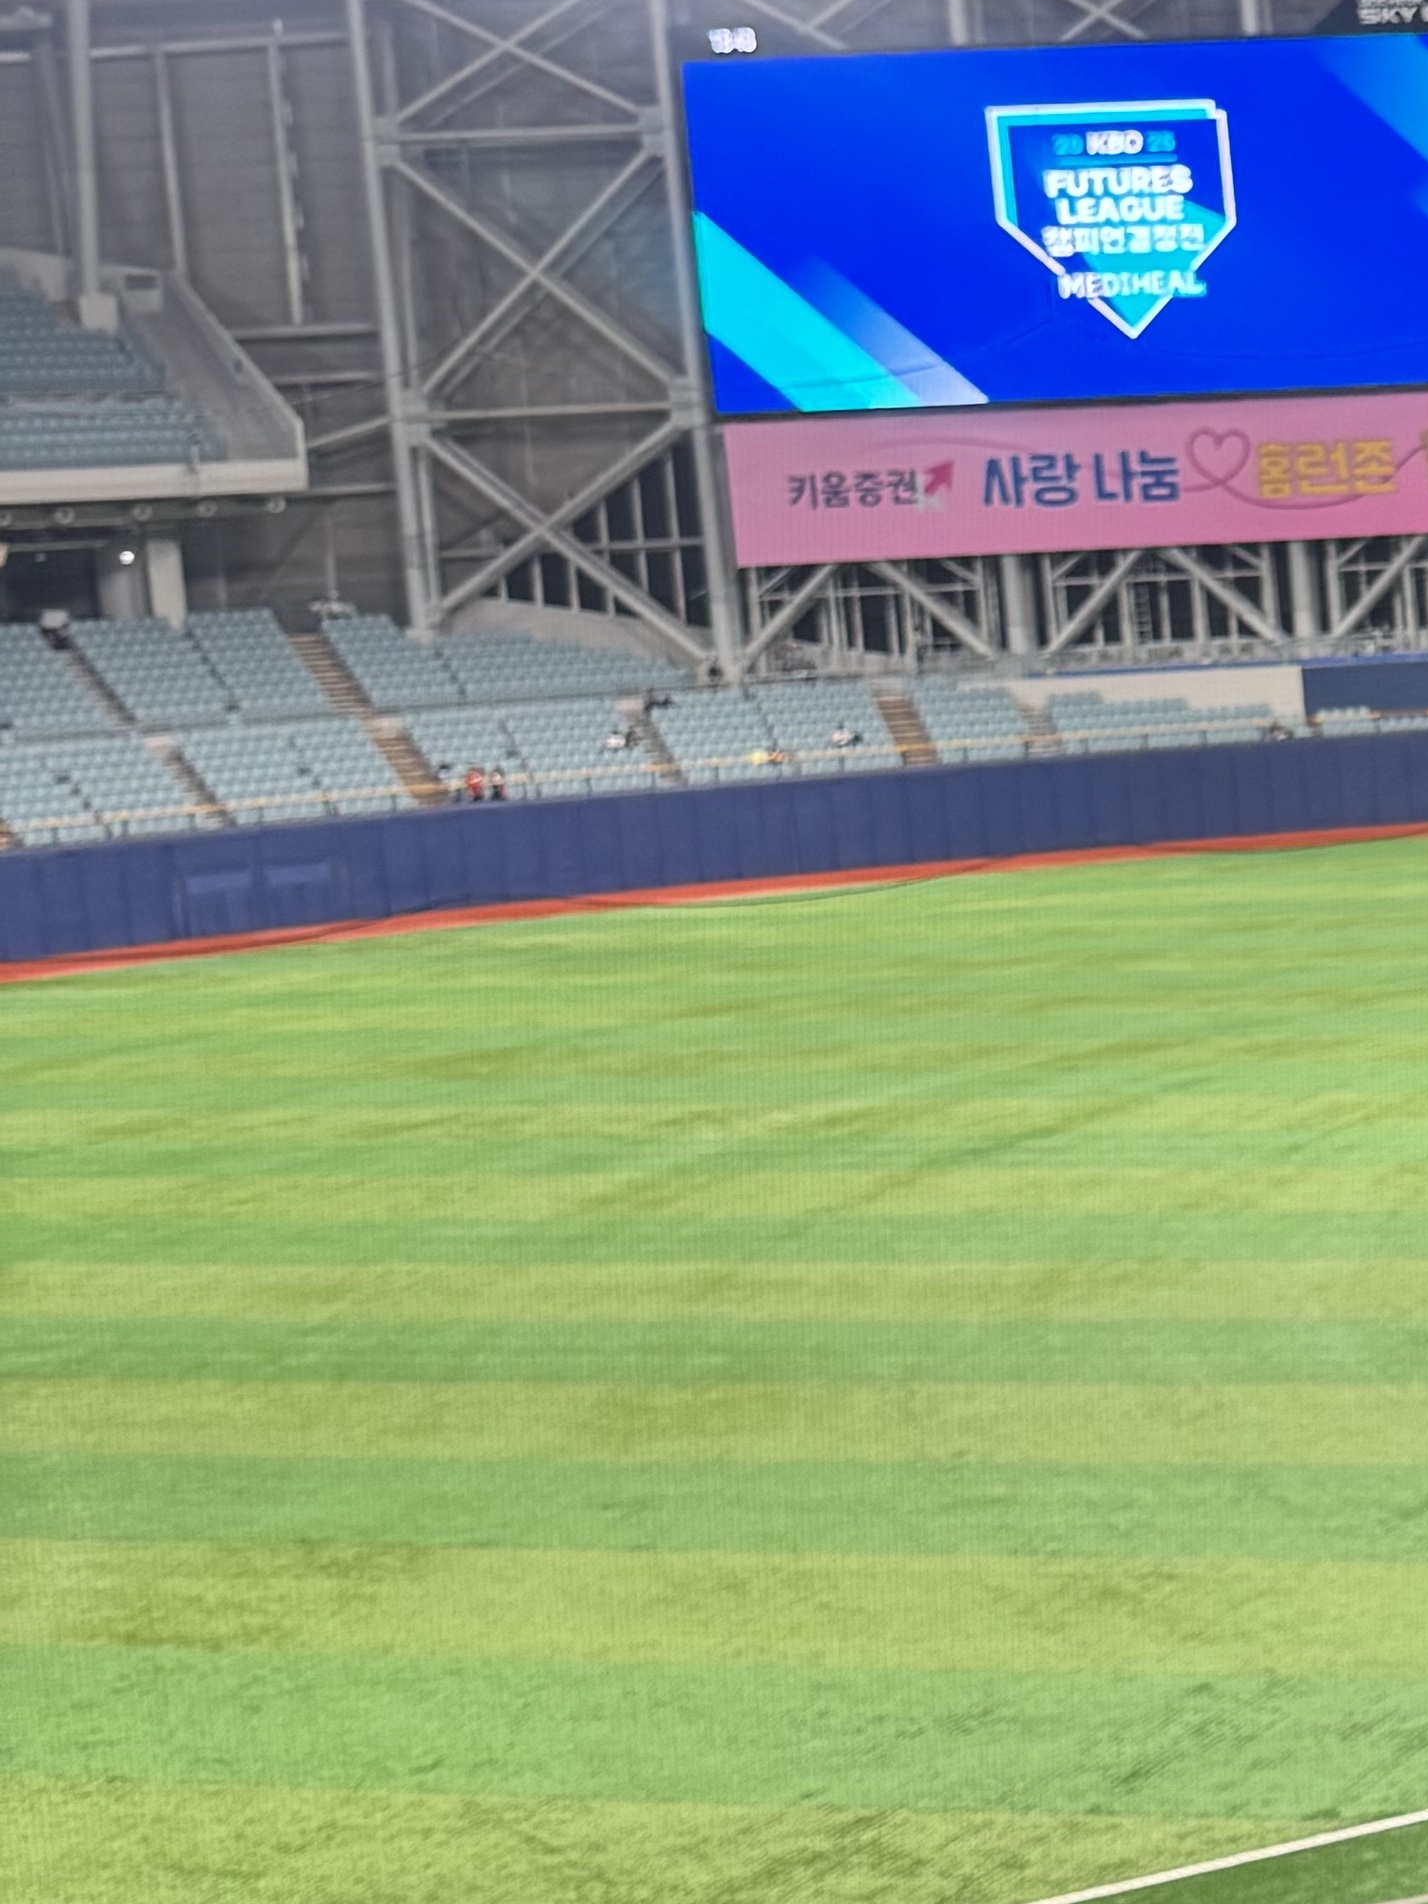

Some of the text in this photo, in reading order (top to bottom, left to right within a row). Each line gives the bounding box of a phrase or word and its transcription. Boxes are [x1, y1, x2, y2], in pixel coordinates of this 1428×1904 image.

[1358, 5, 1418, 25] SKY
[1086, 129, 1144, 155] KBO
[1043, 164, 1193, 198] FUTURES
[1055, 195, 1185, 225] LEAGUE
[1057, 270, 1207, 299] MEDIHEAL
[787, 441, 1396, 510] 키움증권 사랑 나눔 홈런존
